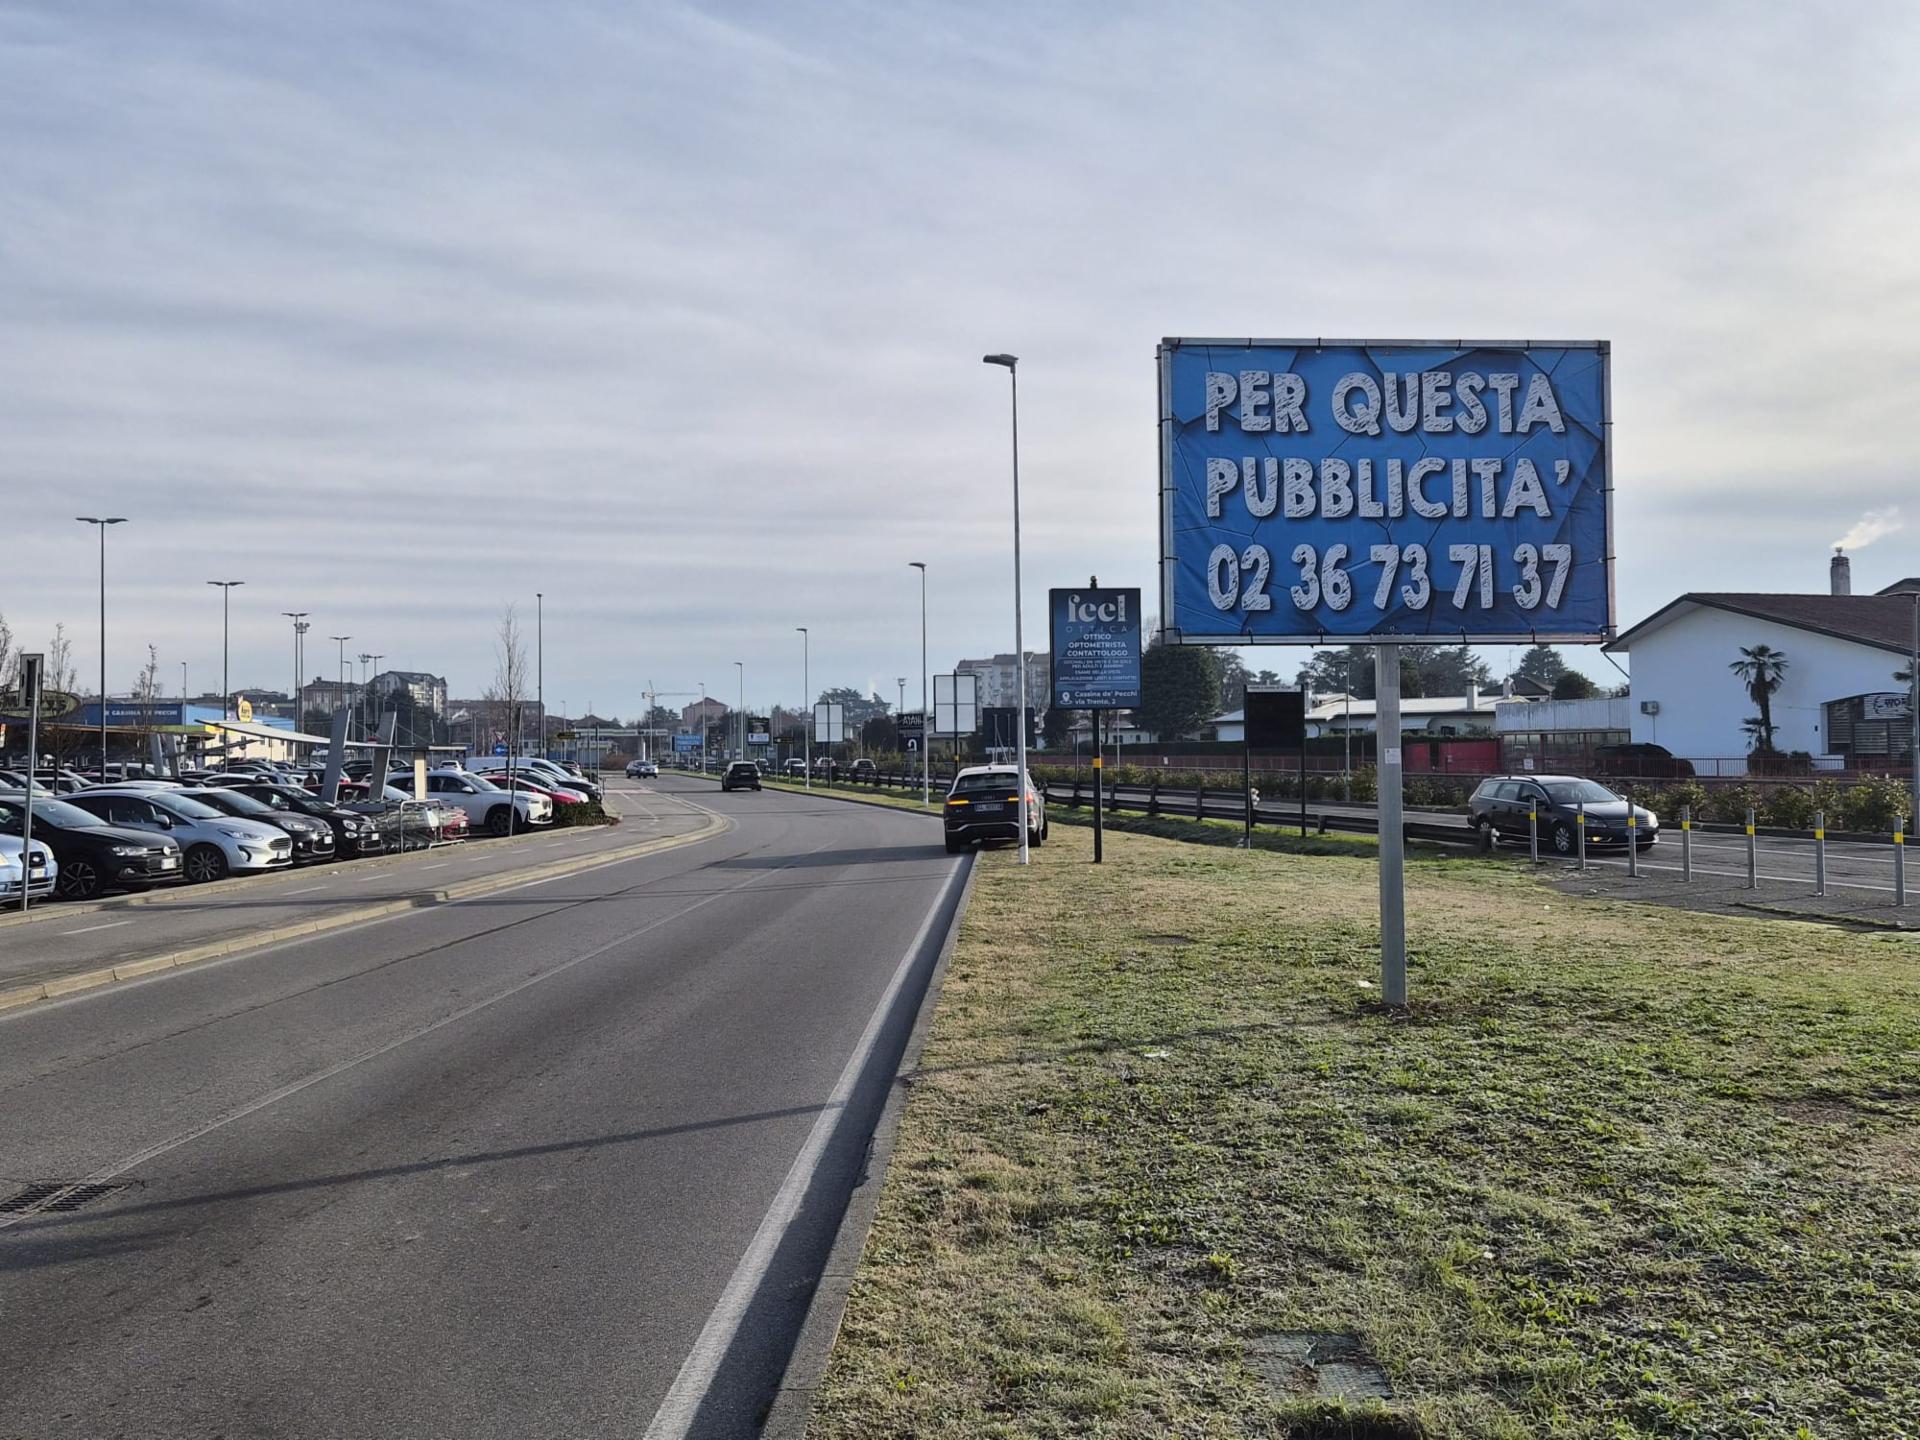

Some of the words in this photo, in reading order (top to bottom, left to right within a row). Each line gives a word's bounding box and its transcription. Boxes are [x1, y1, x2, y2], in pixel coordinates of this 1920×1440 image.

[1205, 370, 1309, 433] PER
[1331, 370, 1566, 436] QUESTA
[1206, 457, 1570, 518] PUBBLICITA'
[1207, 543, 1271, 611] 02
[1290, 543, 1352, 611] 36
[1370, 543, 1431, 610] 73
[1449, 543, 1494, 610] 71
[1512, 543, 1573, 610] 37
[1068, 641, 1127, 649] OPTOMETRISTA
